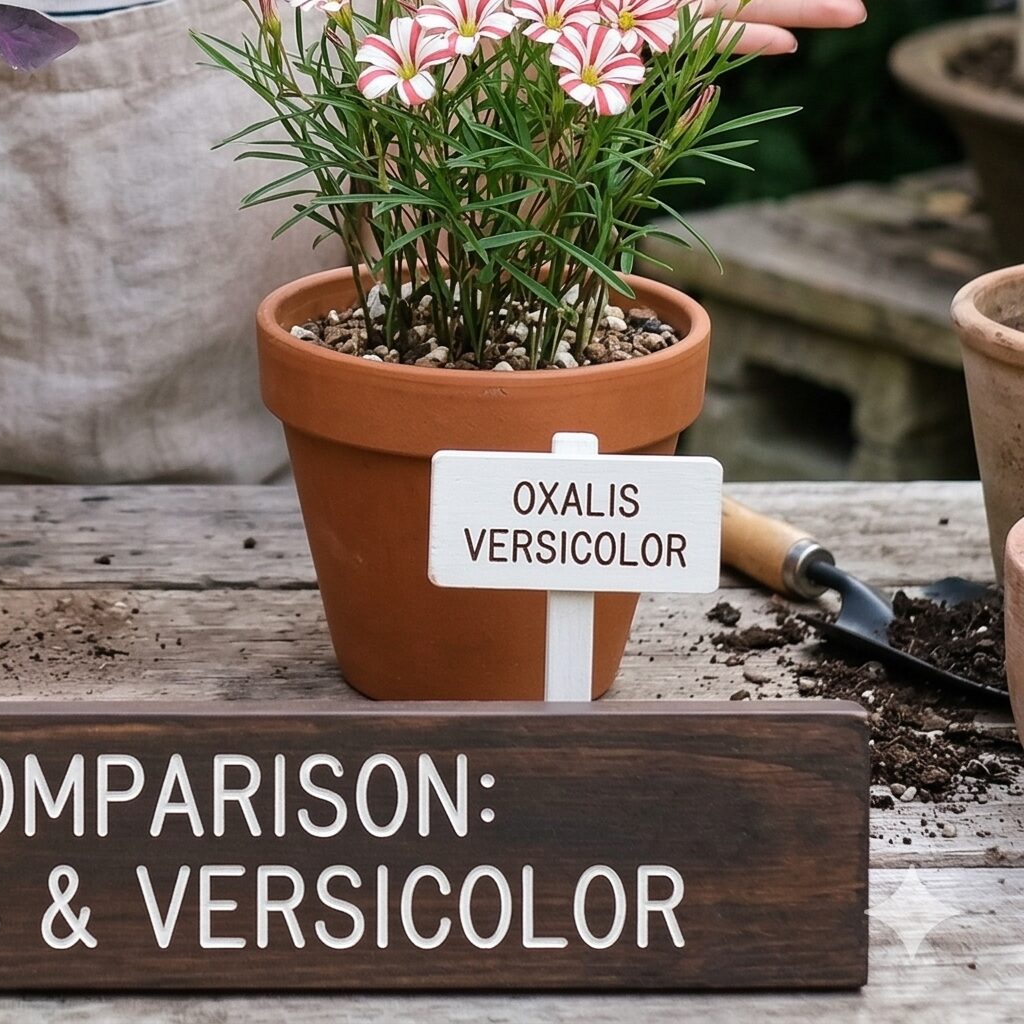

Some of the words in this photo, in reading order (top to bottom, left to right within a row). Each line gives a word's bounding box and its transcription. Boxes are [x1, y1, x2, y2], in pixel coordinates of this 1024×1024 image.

[513, 480, 640, 518] OXALIS
[463, 527, 687, 568] VERSICOLOR
[41, 864, 98, 950] &
[136, 864, 685, 950] VERSICOLOR
